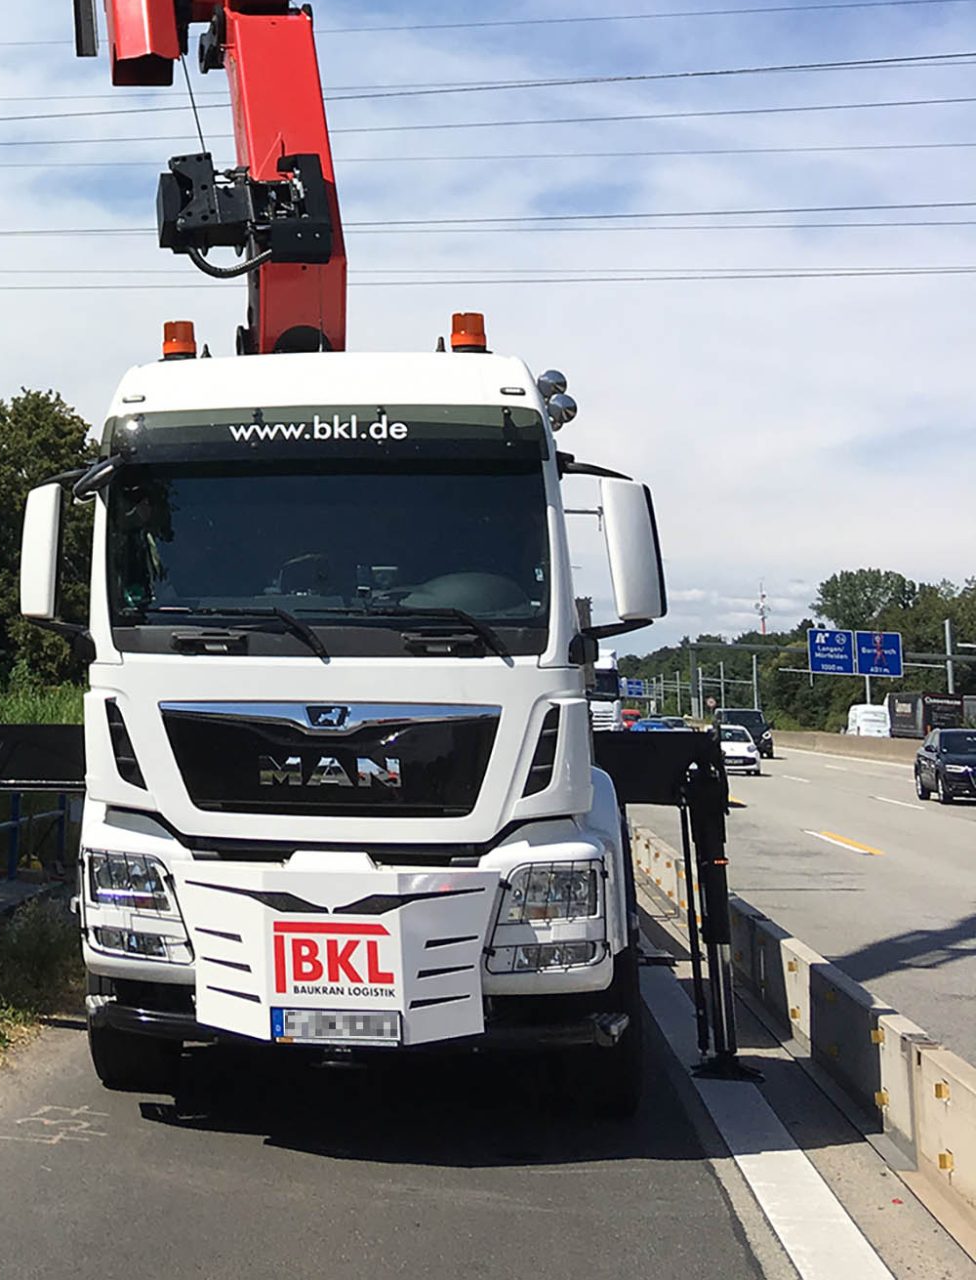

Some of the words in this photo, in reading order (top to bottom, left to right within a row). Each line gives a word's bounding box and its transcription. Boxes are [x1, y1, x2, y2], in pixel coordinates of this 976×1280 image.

[229, 414, 408, 442] www.bkl.de
[258, 755, 402, 788] MAN
[291, 938, 395, 984] BKL
[293, 985, 345, 996] BAUKRAN
[347, 986, 396, 998] LOGISTIK
